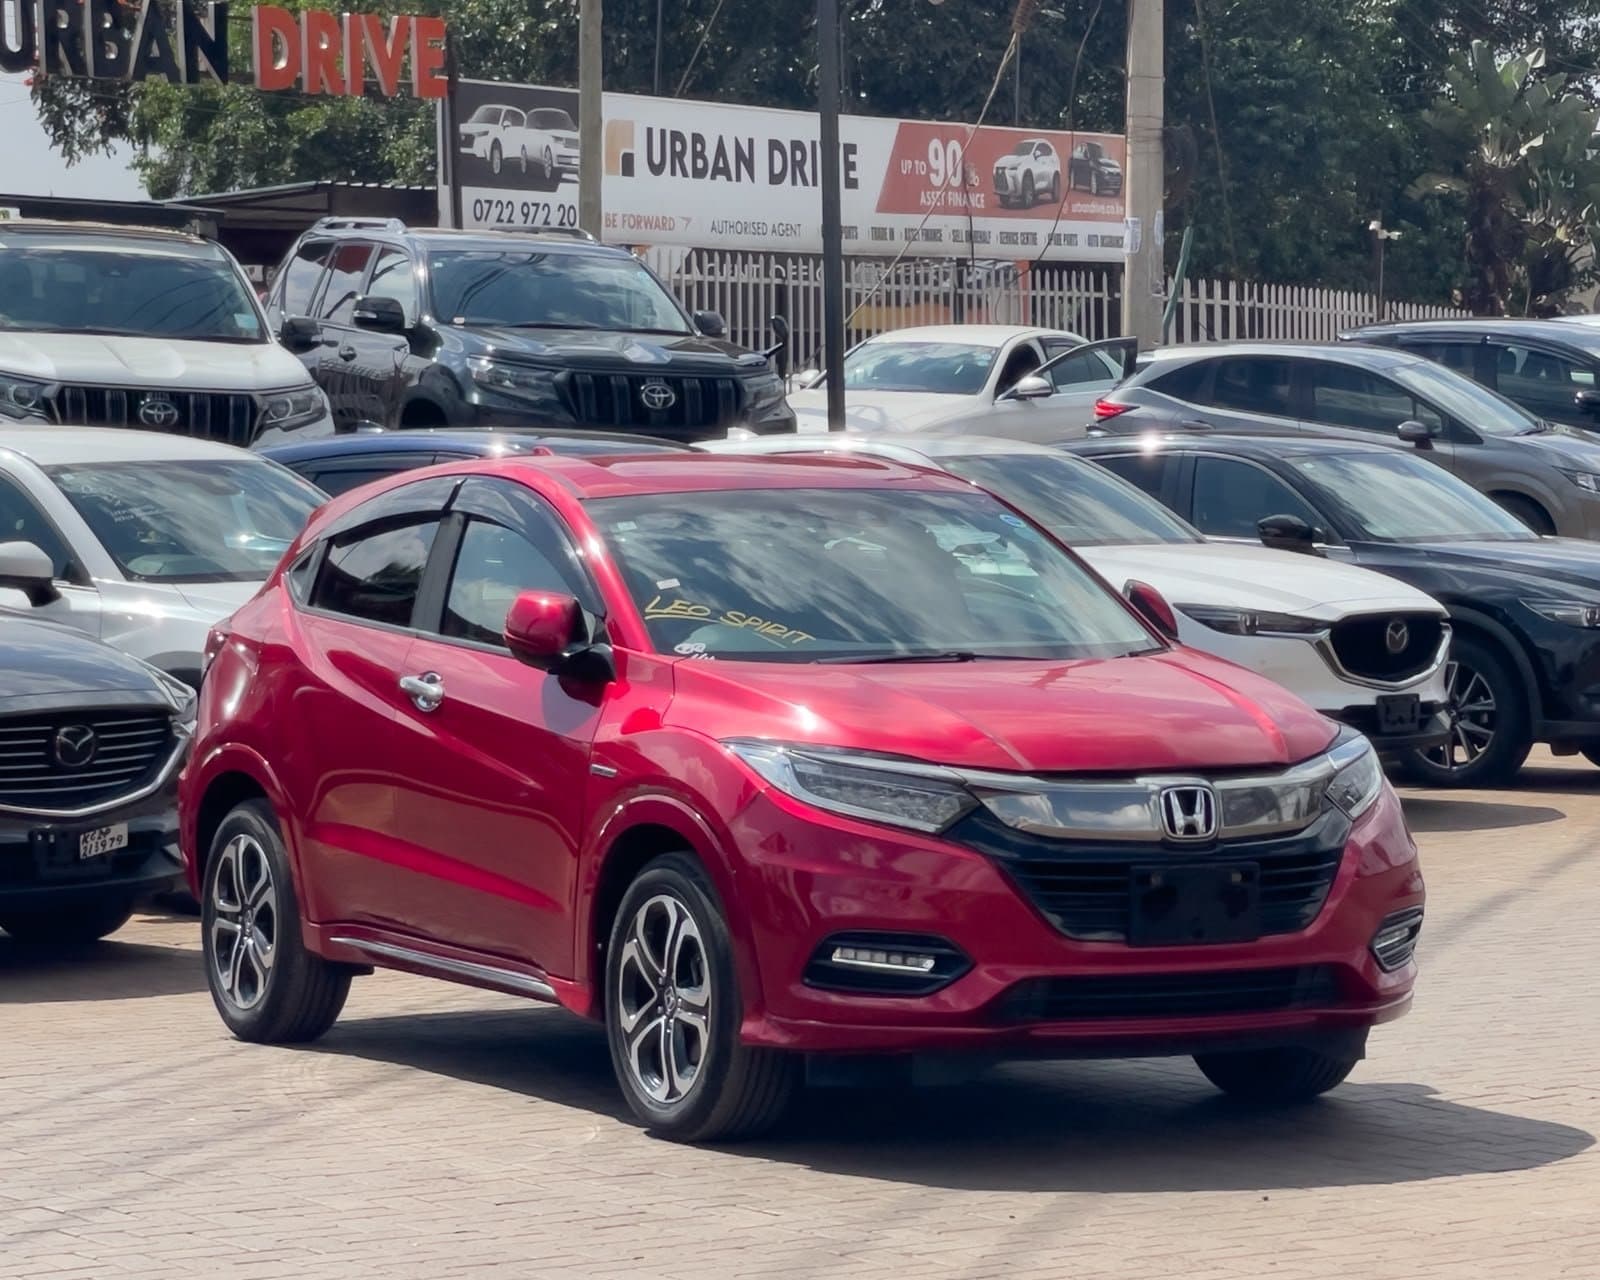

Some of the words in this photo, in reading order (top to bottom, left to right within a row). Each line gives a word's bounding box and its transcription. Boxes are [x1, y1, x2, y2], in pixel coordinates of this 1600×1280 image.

[0, 0, 229, 85] URBAN
[252, 5, 449, 99] DRIVE
[646, 126, 756, 184] URBAN
[767, 138, 859, 190] DRIE
[900, 159, 913, 175] UP
[914, 160, 927, 176] TO
[947, 191, 985, 209] FINANCE
[473, 199, 515, 224] 0722
[521, 202, 552, 226] 972
[557, 204, 578, 228] 20
[603, 212, 618, 229] BE
[622, 213, 676, 231] FORWARD
[710, 219, 768, 237] AUTHORISED
[771, 222, 802, 238] AGENT
[645, 595, 711, 617] LEO
[719, 611, 817, 645] SPIRIT
